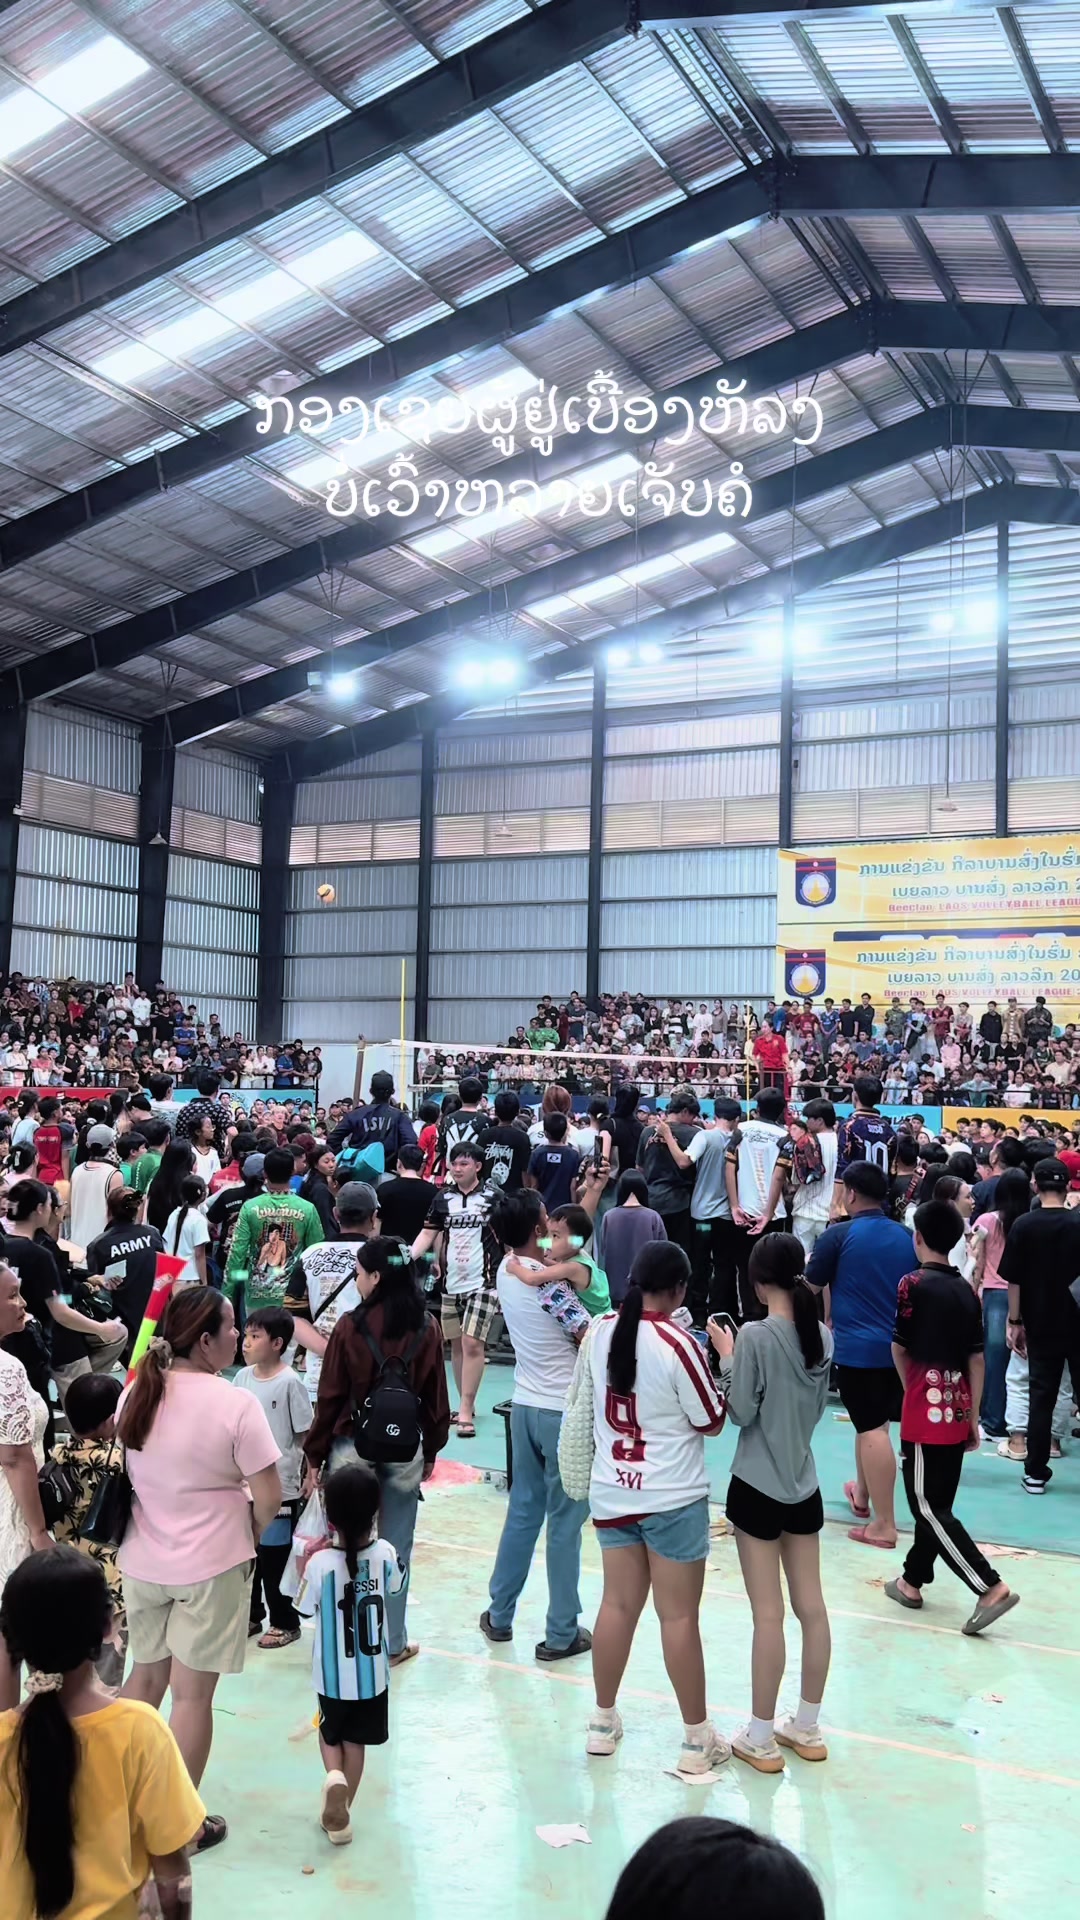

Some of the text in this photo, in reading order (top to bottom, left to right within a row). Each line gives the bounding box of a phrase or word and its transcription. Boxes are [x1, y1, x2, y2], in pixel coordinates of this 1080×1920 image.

[892, 884, 949, 898] ເບຍລາວ
[972, 899, 1040, 910] VOLLEYBALL
[888, 972, 942, 984] ເບຍລາວ
[961, 988, 1028, 997] VOLLEYBALL
[1032, 988, 1072, 996] LEAGUE
[444, 1214, 491, 1229] JOHN
[110, 1236, 151, 1258] ARMY
[605, 1385, 647, 1462] 9
[615, 1467, 642, 1490] XVI
[354, 1578, 379, 1593] ESSI
[338, 1595, 383, 1658] 10
